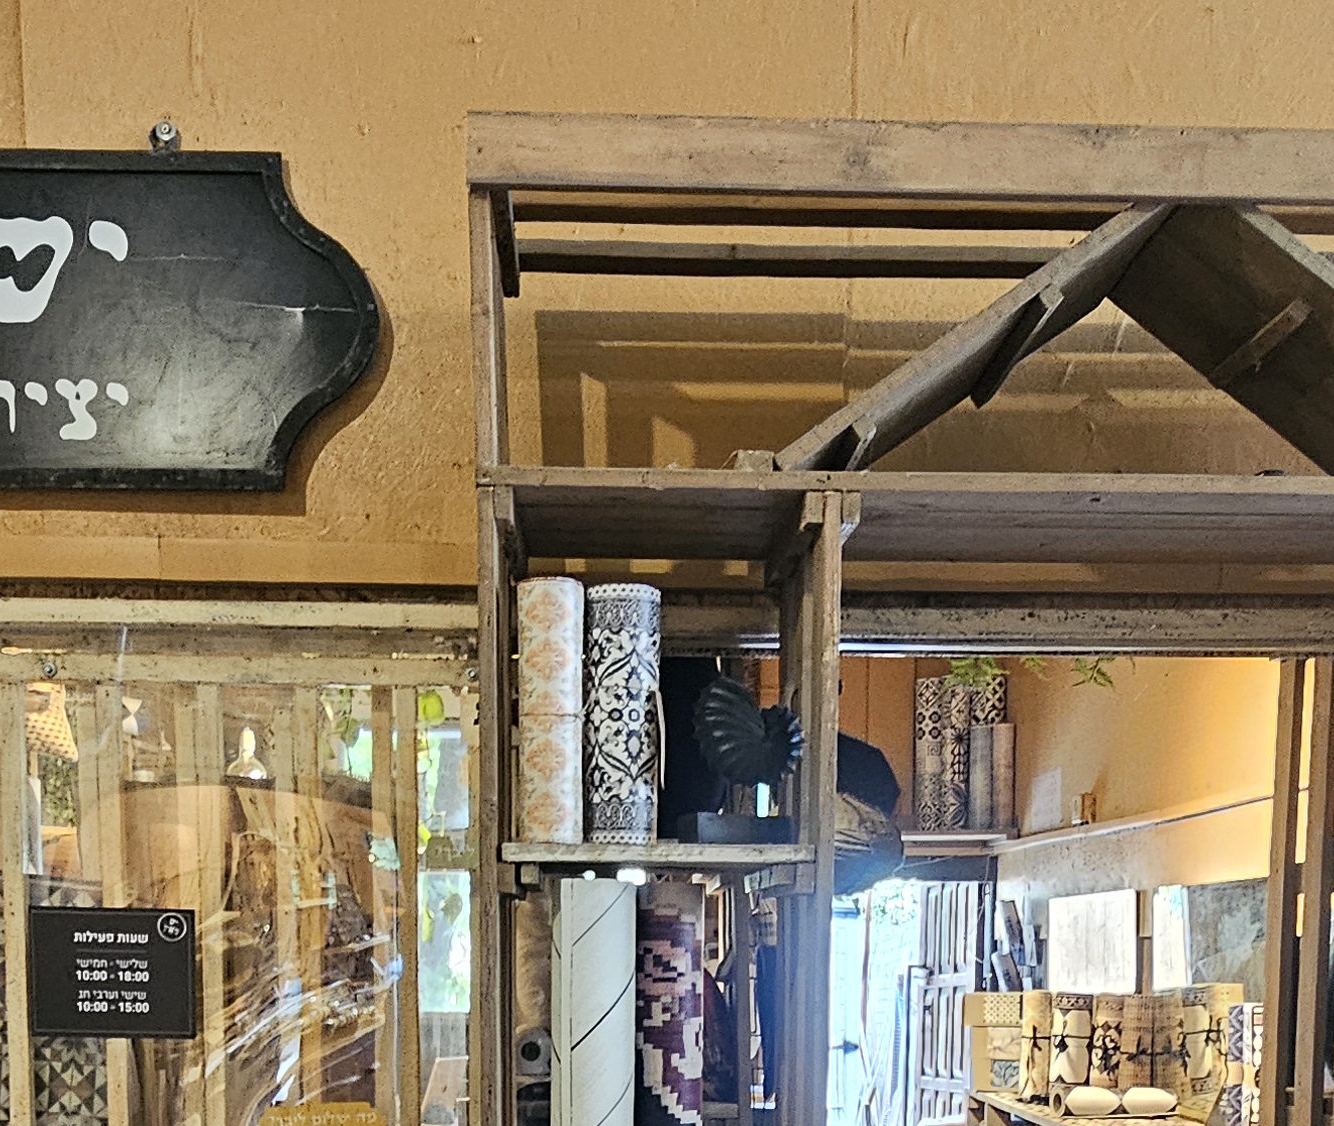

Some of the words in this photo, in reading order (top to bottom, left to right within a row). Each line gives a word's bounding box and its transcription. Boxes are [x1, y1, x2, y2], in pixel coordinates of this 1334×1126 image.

[73, 930, 115, 943] פעילות
[116, 933, 149, 944] שעות
[76, 958, 108, 969] חמישי
[115, 958, 148, 969] שלישי
[76, 969, 108, 981] 10:00
[117, 970, 150, 982] 18:00
[120, 990, 147, 1000] שישי
[76, 1001, 108, 1013] 10:00
[118, 1002, 150, 1013] 15:00
